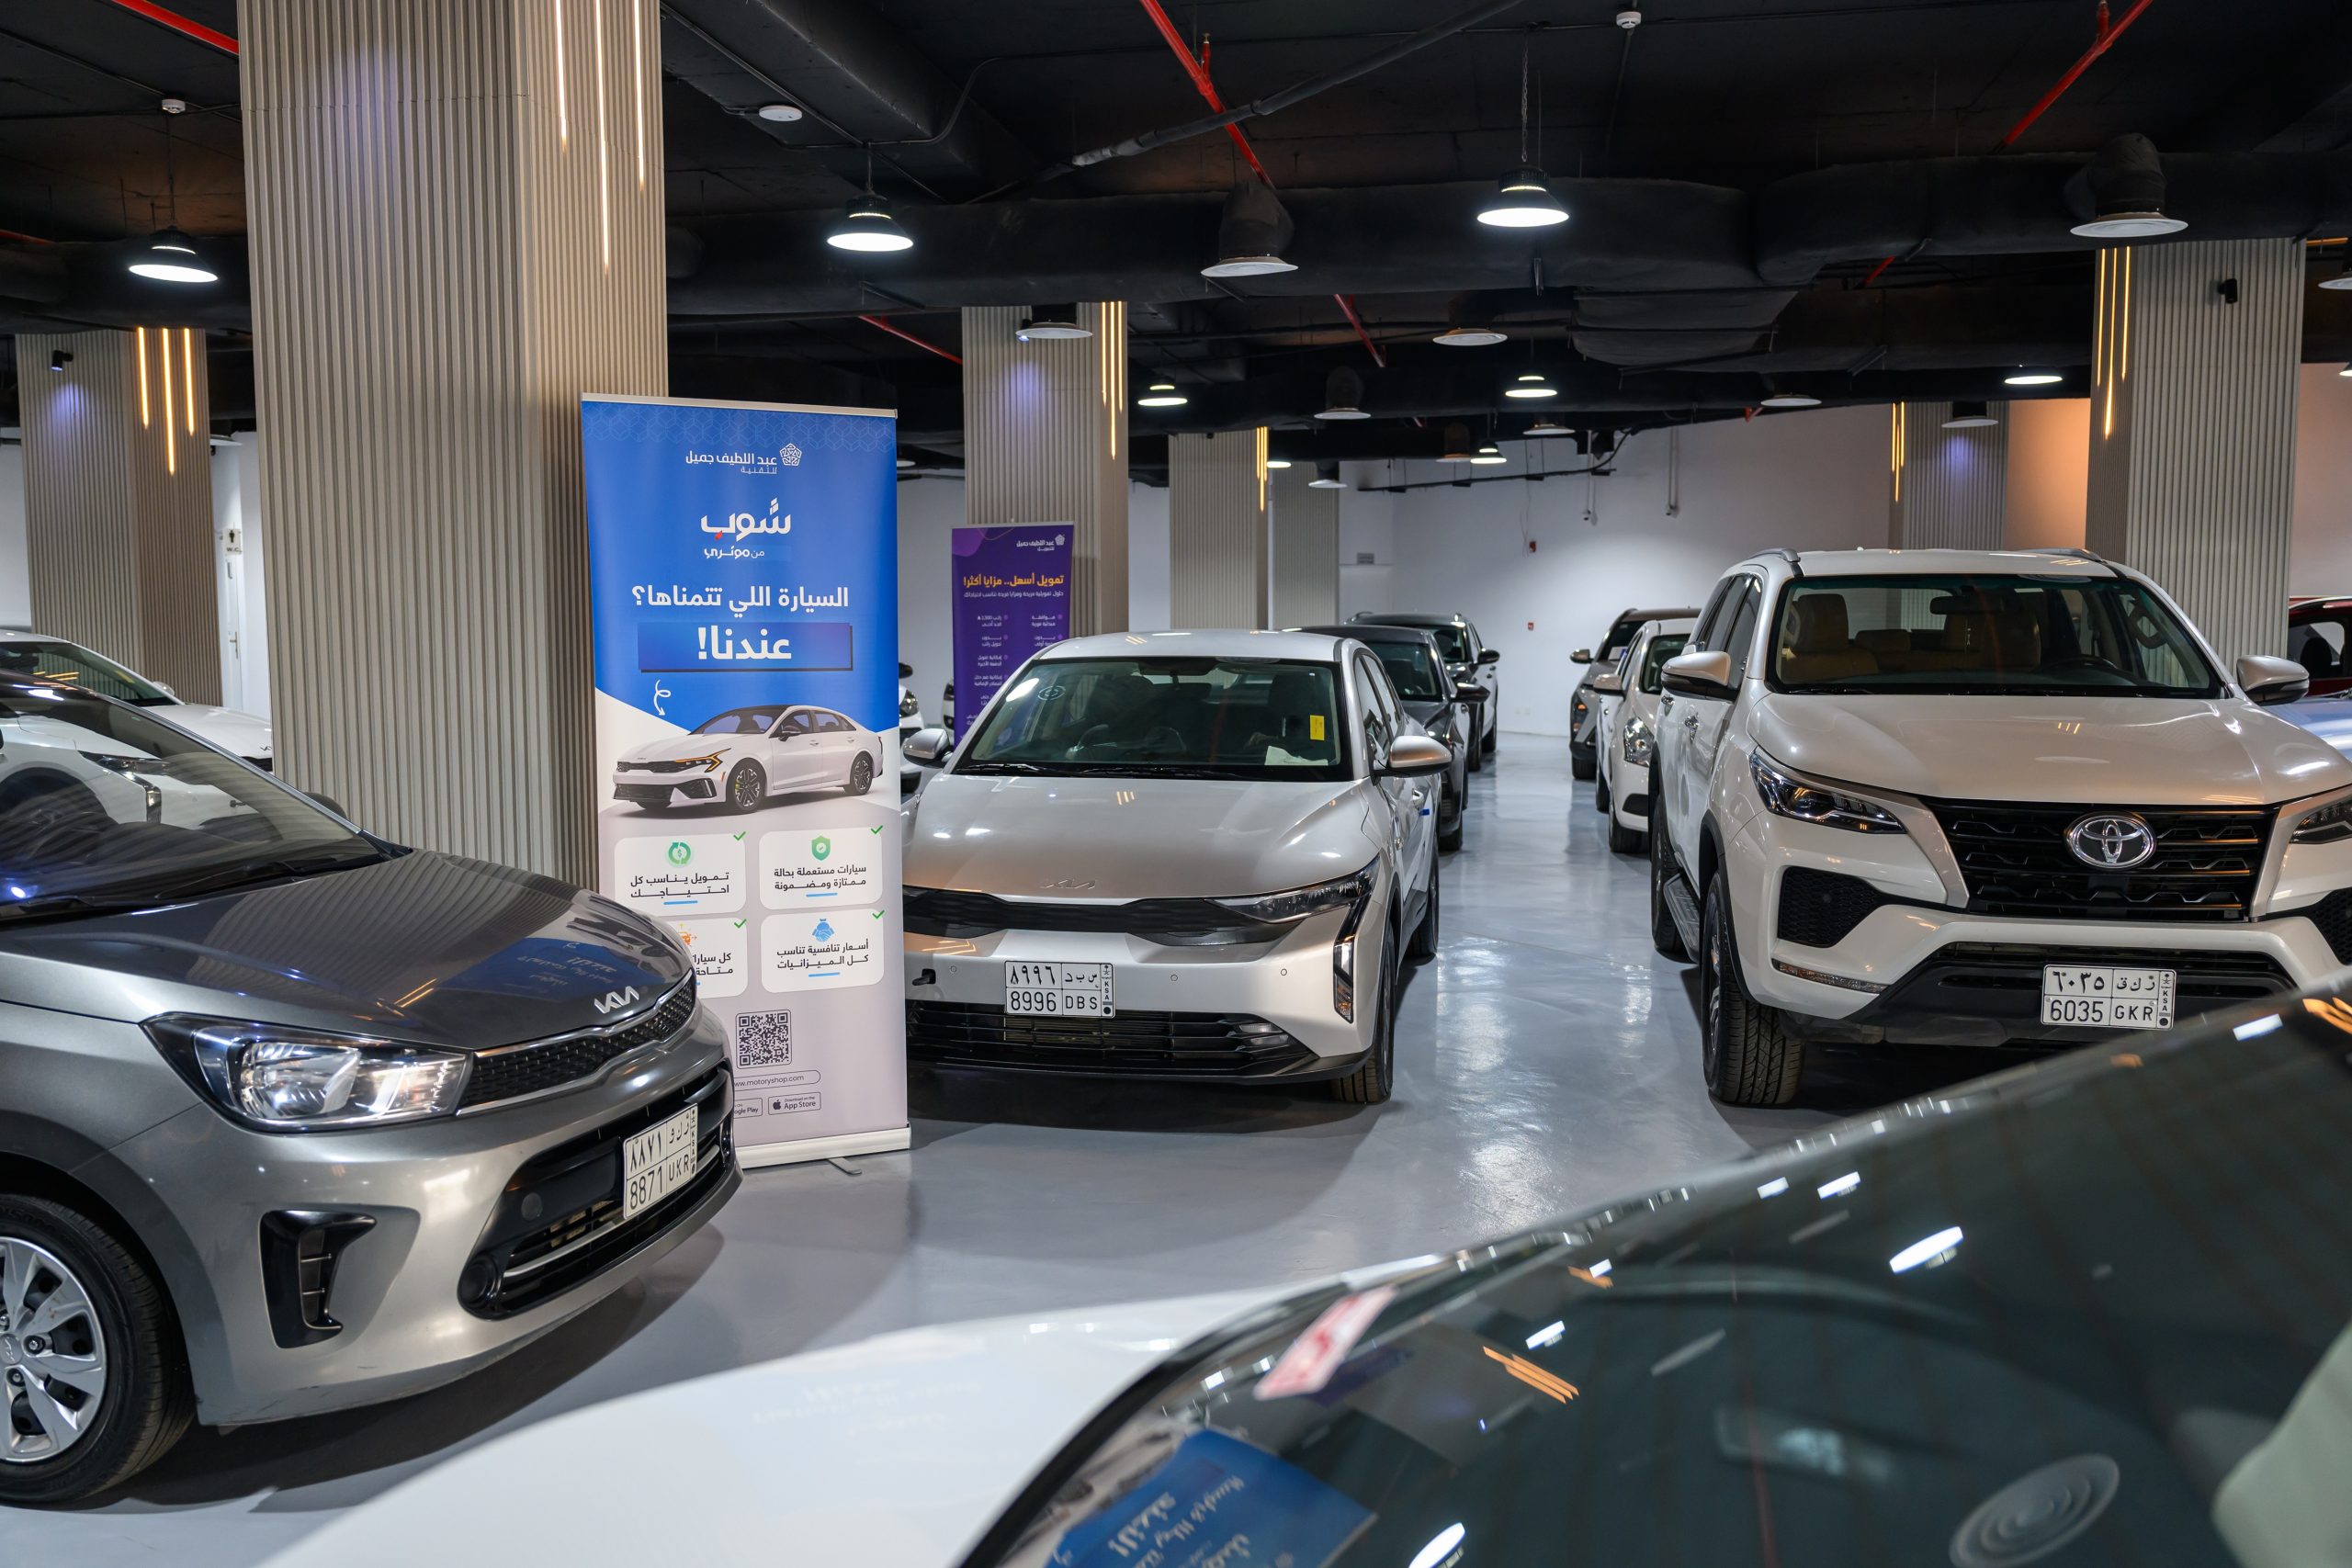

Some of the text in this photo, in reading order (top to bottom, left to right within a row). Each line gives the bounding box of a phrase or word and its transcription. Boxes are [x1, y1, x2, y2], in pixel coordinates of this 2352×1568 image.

[685, 450, 777, 467] عبد اللطيف جميل
[751, 550, 765, 559] من
[983, 575, 1002, 588] مزايا
[1037, 574, 1065, 587] تمويل
[631, 584, 849, 618] السيارة اللي تتمناها؟
[697, 625, 792, 660] عندنا!
[774, 864, 866, 878] سيارات مستعملة بحالة
[630, 872, 729, 887] تمويل يناسب كل
[775, 877, 866, 892] ممتازة ومضمونة
[630, 885, 729, 899] احتياجك
[776, 938, 869, 958] أسعار تنافسية تناسب
[692, 952, 732, 965] كل سيارا
[777, 953, 869, 971] كل الميزانيات
[695, 966, 734, 976] متاحة
[1011, 964, 1056, 986] ٨٩٩٦
[2052, 971, 2105, 994] ٦٠٣٥
[1011, 991, 1057, 1012] 8996
[2051, 999, 2104, 1023] 6035
[734, 1075, 805, 1088] ww.motoryshop.com
[747, 1106, 759, 1114] Play
[784, 1102, 798, 1111] App
[629, 1165, 662, 1210] 8871
